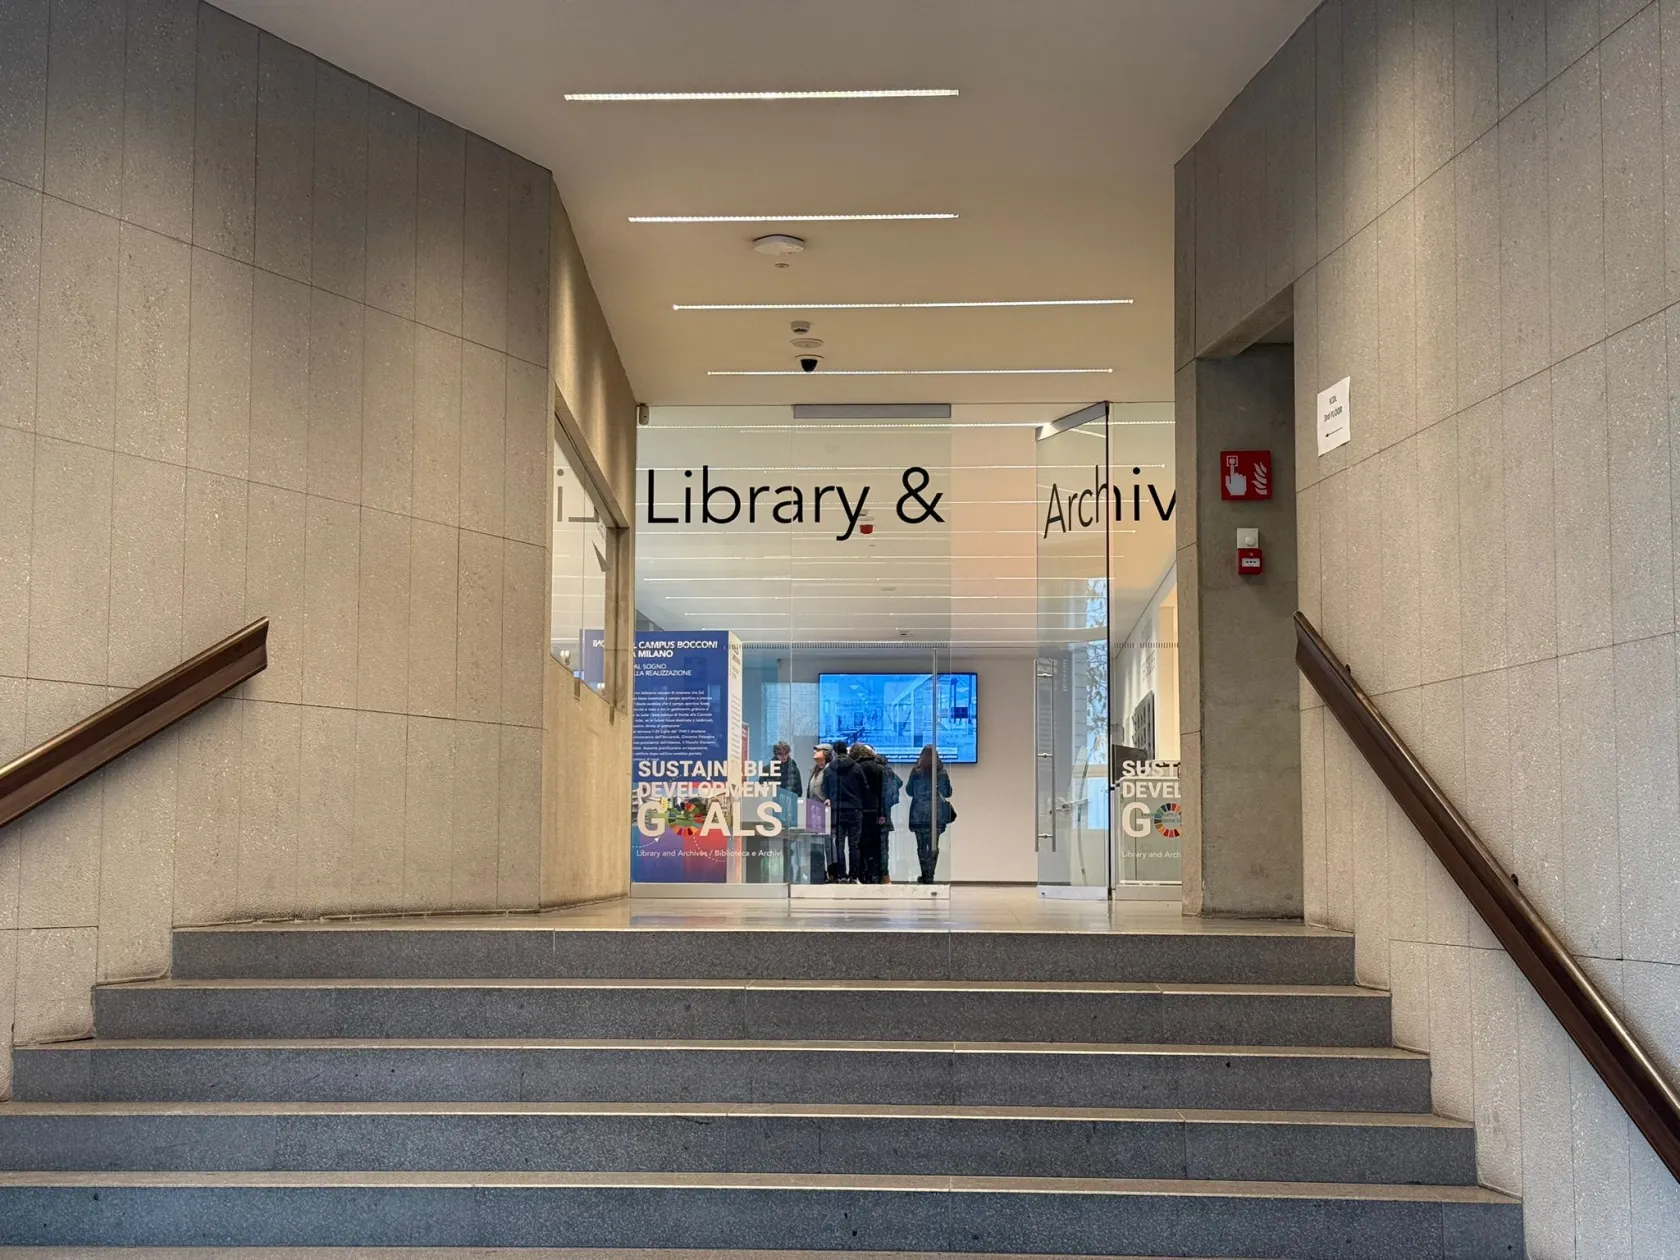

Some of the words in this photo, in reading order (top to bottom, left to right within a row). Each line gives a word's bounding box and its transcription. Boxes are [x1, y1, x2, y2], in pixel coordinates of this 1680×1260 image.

[648, 465, 871, 541] Library
[896, 466, 946, 524] &
[638, 641, 675, 649] CAMPUS
[676, 641, 718, 649] BOCCONI
[638, 650, 674, 658] MILANO
[638, 759, 782, 778] SUSTAINBLE
[638, 781, 781, 799] DEVELOPMENT
[1122, 781, 1181, 799] DEVEL
[636, 849, 661, 859] Library
[662, 849, 676, 857] and
[714, 849, 750, 857] Biblioteca
[1122, 850, 1147, 860] Library
